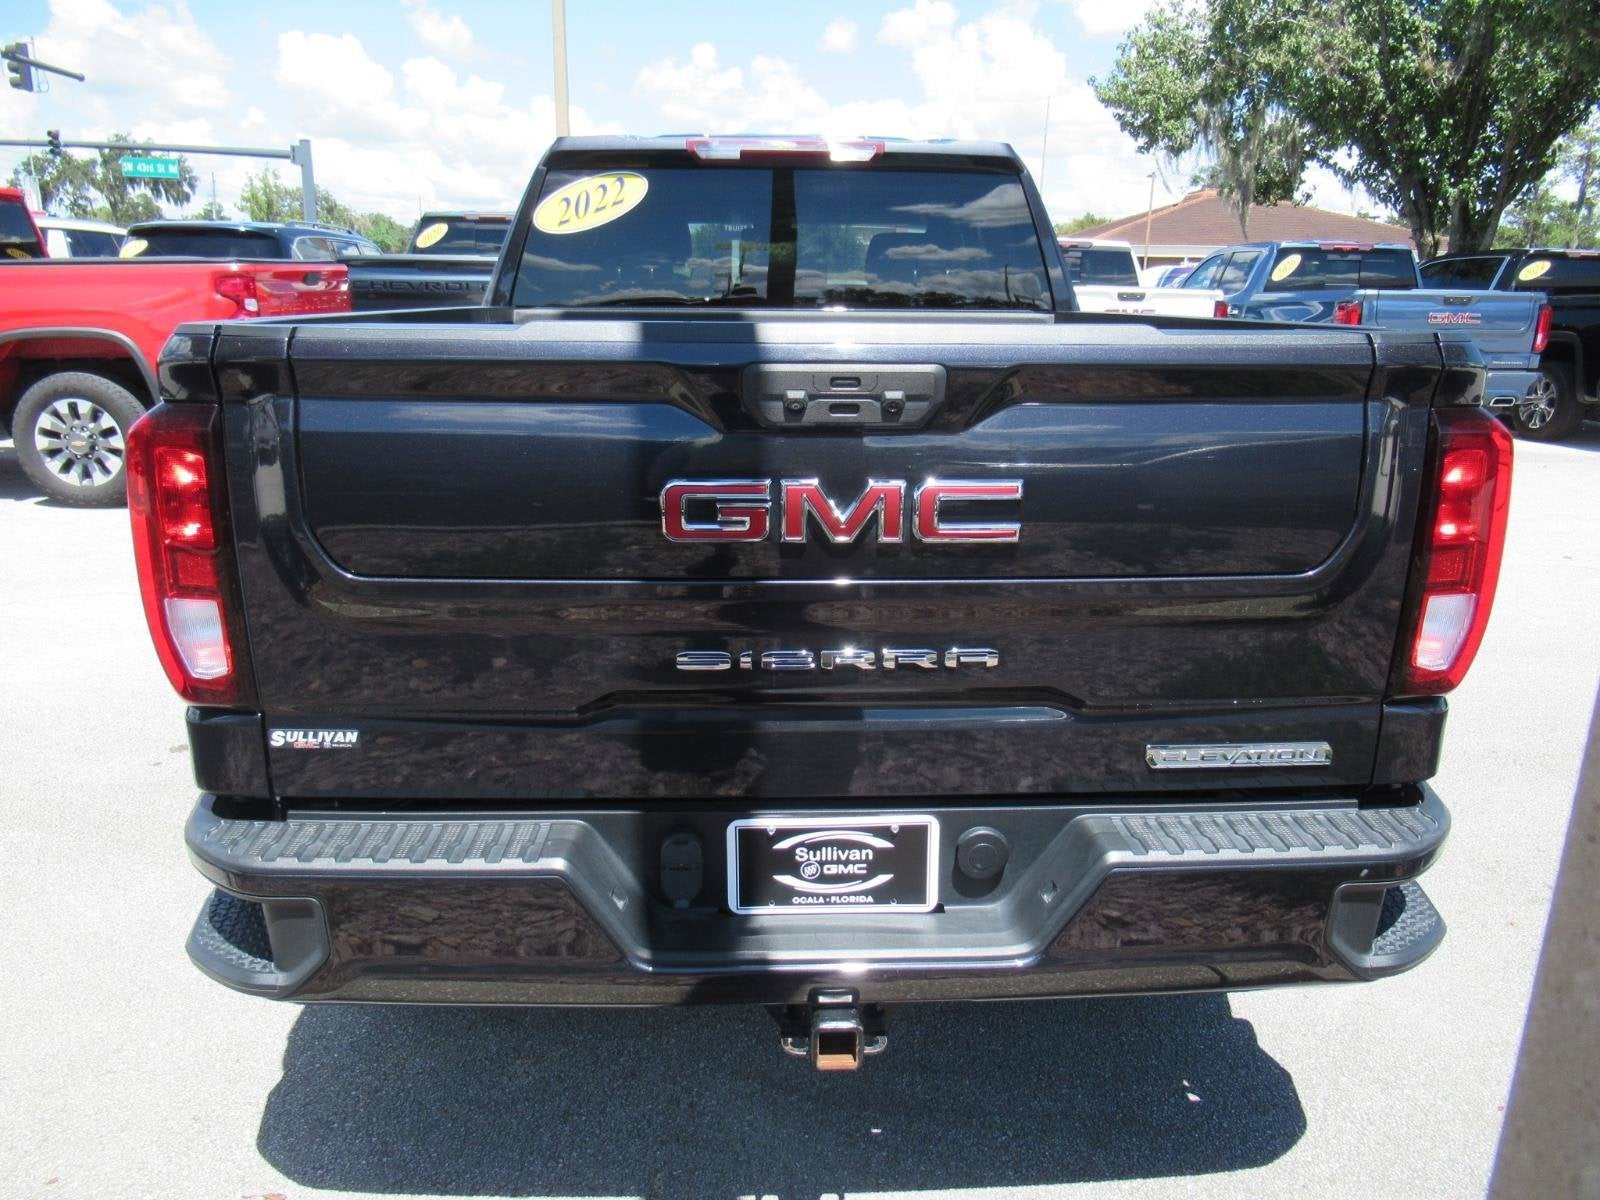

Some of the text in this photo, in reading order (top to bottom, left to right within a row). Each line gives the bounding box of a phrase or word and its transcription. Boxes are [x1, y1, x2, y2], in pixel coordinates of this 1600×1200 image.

[557, 176, 626, 226] 2022
[352, 280, 489, 292] CHEVROLE
[1428, 311, 1482, 324] GMC
[659, 477, 1024, 543] GMC
[675, 647, 999, 671] SIERRA
[270, 730, 358, 747] SULLIVAN
[1157, 747, 1326, 764] ELEVATION
[795, 846, 873, 862] Sullivan
[822, 863, 867, 875] GMC
[791, 895, 874, 904] OCALA FLORIDA
